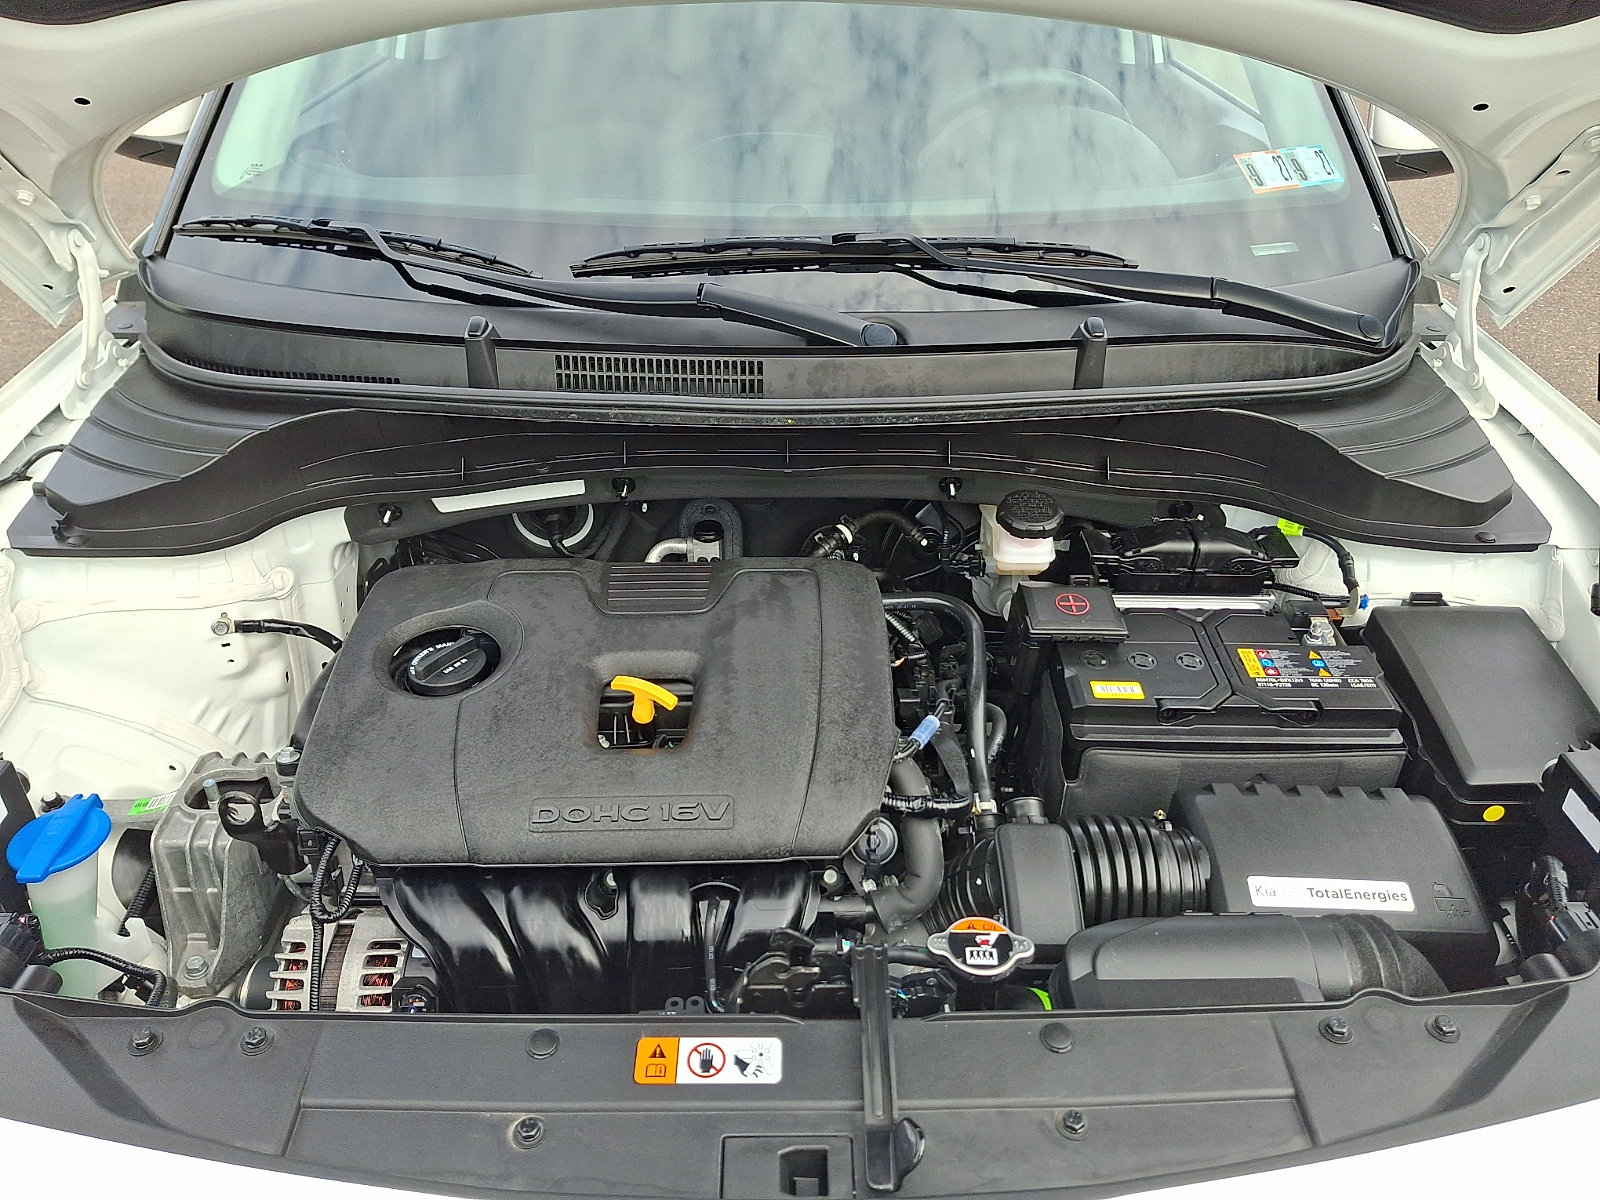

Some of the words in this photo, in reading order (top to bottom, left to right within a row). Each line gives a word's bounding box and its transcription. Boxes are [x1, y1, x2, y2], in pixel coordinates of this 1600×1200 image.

[1271, 155, 1293, 182] 27
[1314, 149, 1335, 176] 27
[531, 803, 650, 825] DOHC
[660, 801, 731, 822] 16V
[1254, 884, 1277, 898] Kia
[1306, 887, 1408, 903] TotalEnergies
